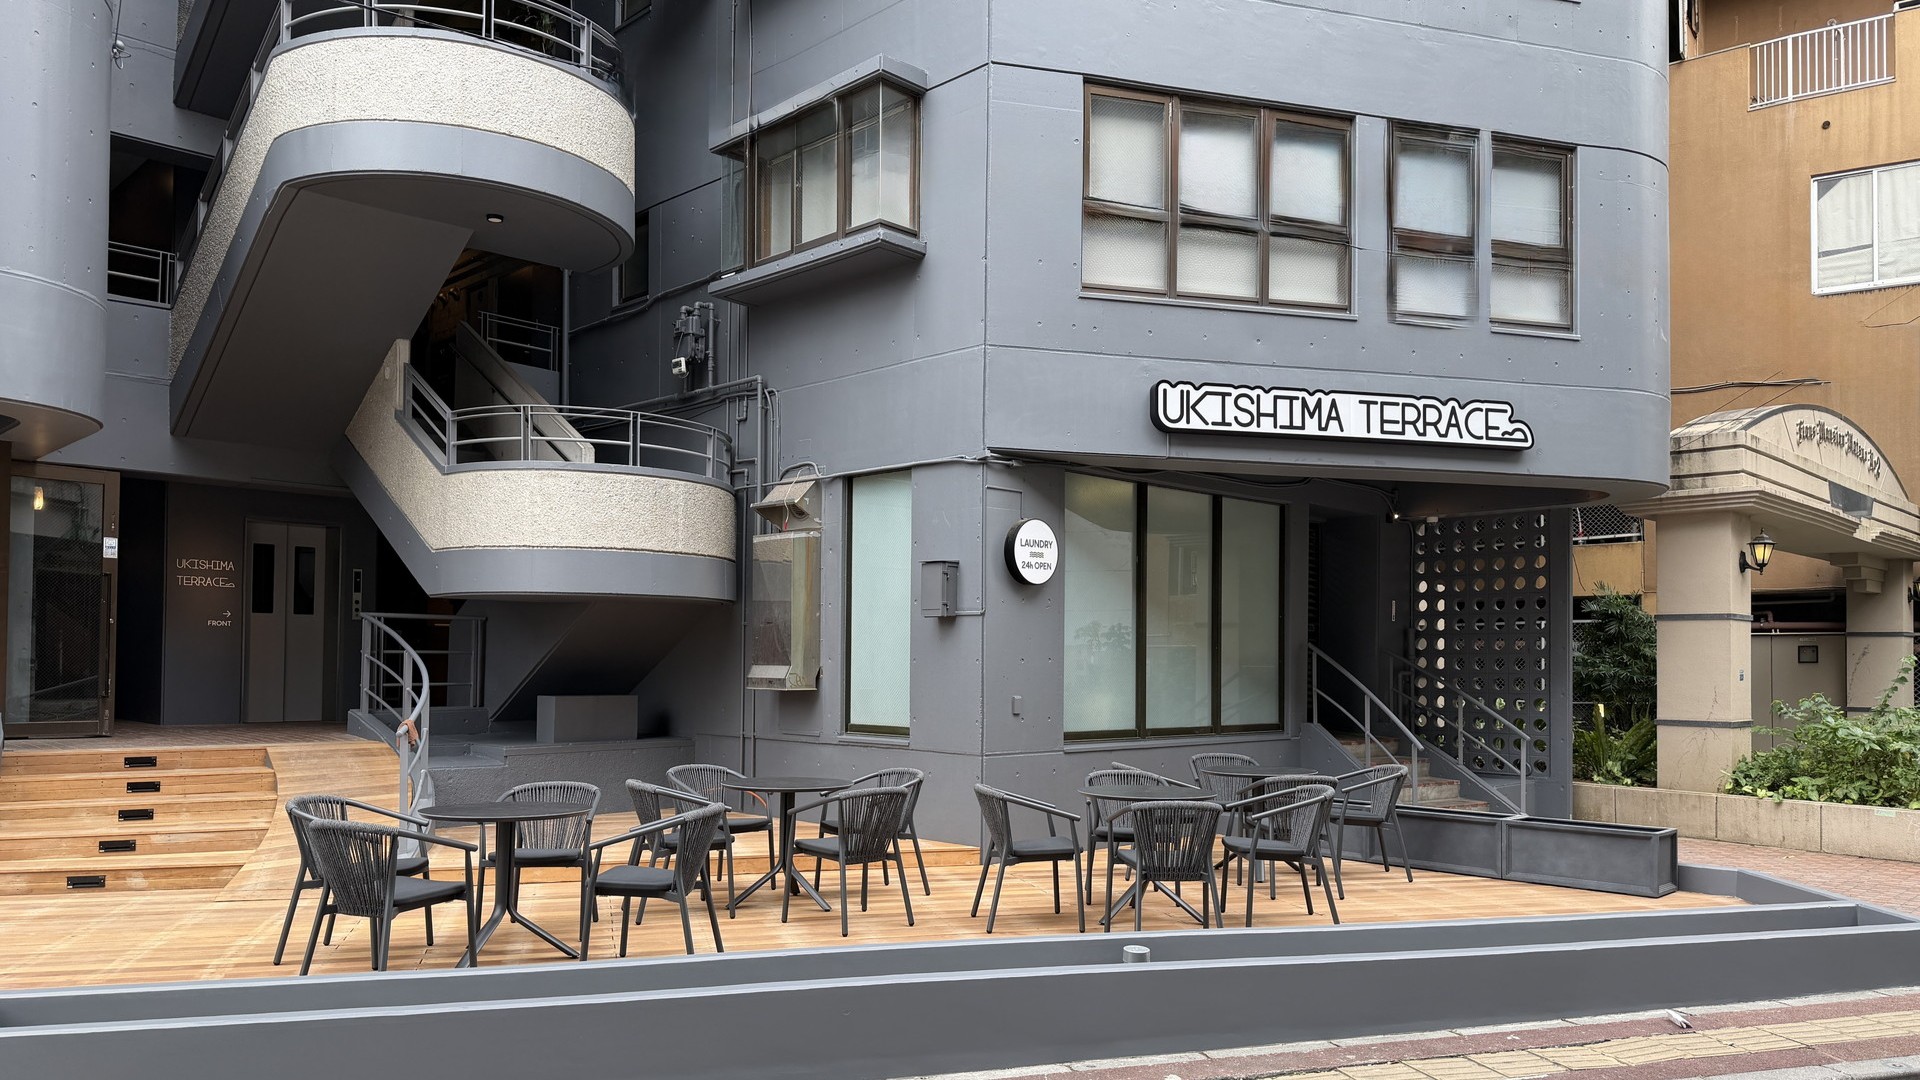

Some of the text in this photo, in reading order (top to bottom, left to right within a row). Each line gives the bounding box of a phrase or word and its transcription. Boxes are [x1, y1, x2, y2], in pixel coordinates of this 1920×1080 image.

[1162, 387, 1510, 442] UKISHIMA TERRACE
[1020, 538, 1053, 549] LAUNDRY
[176, 558, 235, 571] UKISHIMA
[1021, 560, 1052, 570] 24h OPEN
[176, 575, 229, 588] TERRACE
